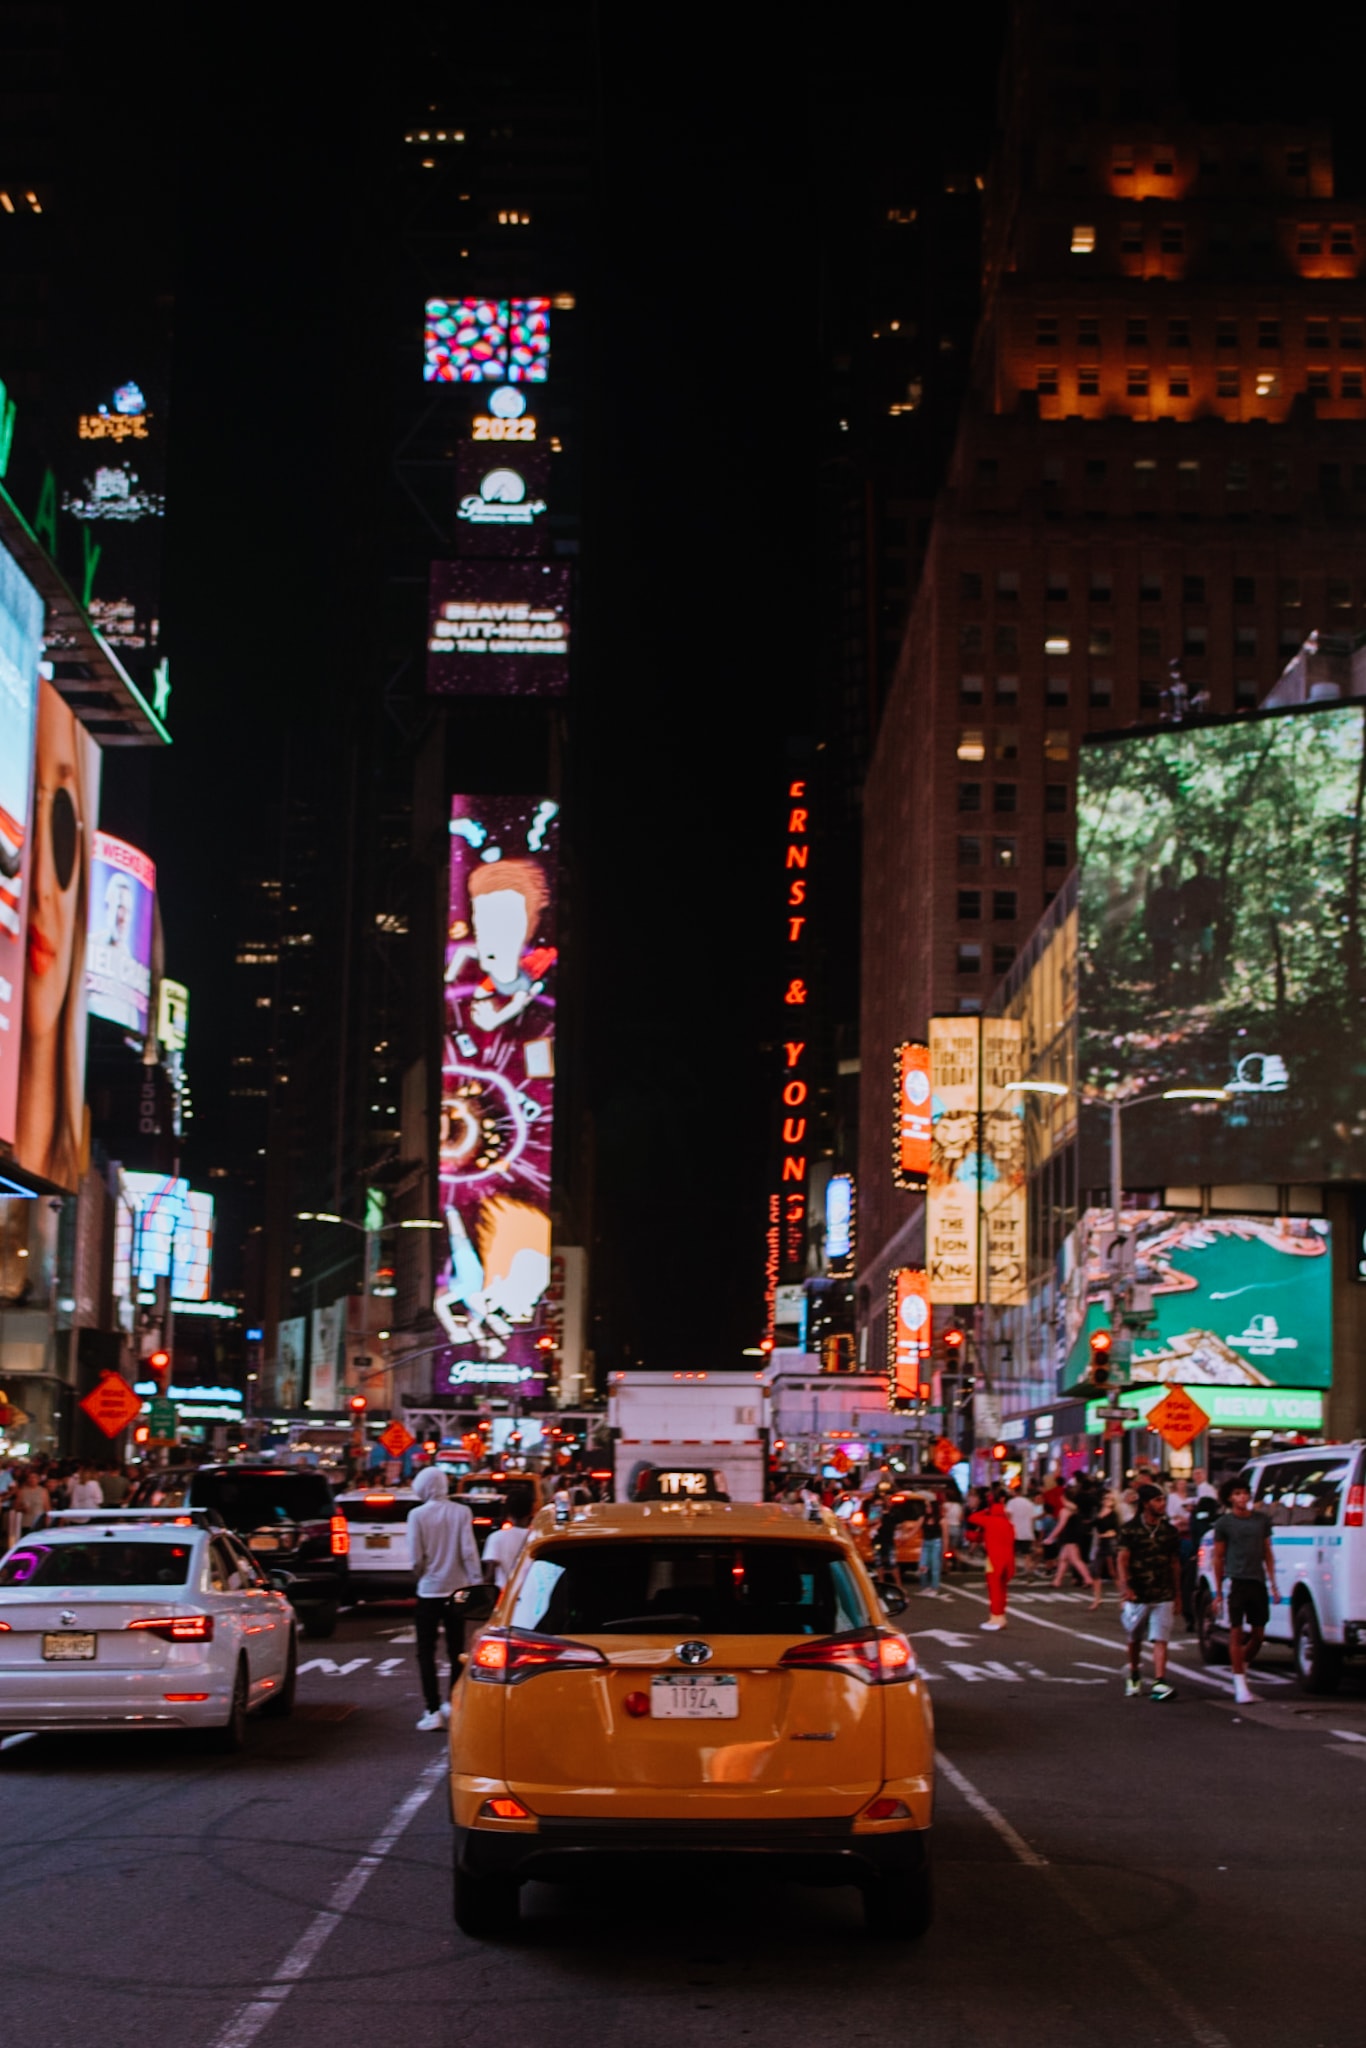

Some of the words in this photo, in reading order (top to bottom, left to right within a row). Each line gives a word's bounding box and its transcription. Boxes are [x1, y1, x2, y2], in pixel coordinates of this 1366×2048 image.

[472, 417, 536, 440] 2022
[444, 602, 530, 620] BEAVIS
[434, 621, 564, 639] BUTT-HEAD
[784, 978, 808, 1005] &
[933, 1067, 974, 1087] TODAY
[940, 1217, 965, 1231] THE
[934, 1234, 969, 1257] LION
[931, 1259, 973, 1282] KING
[1214, 1397, 1268, 1417] NEW
[657, 1472, 708, 1494] 1T92
[671, 1687, 719, 1709] 1T92A
